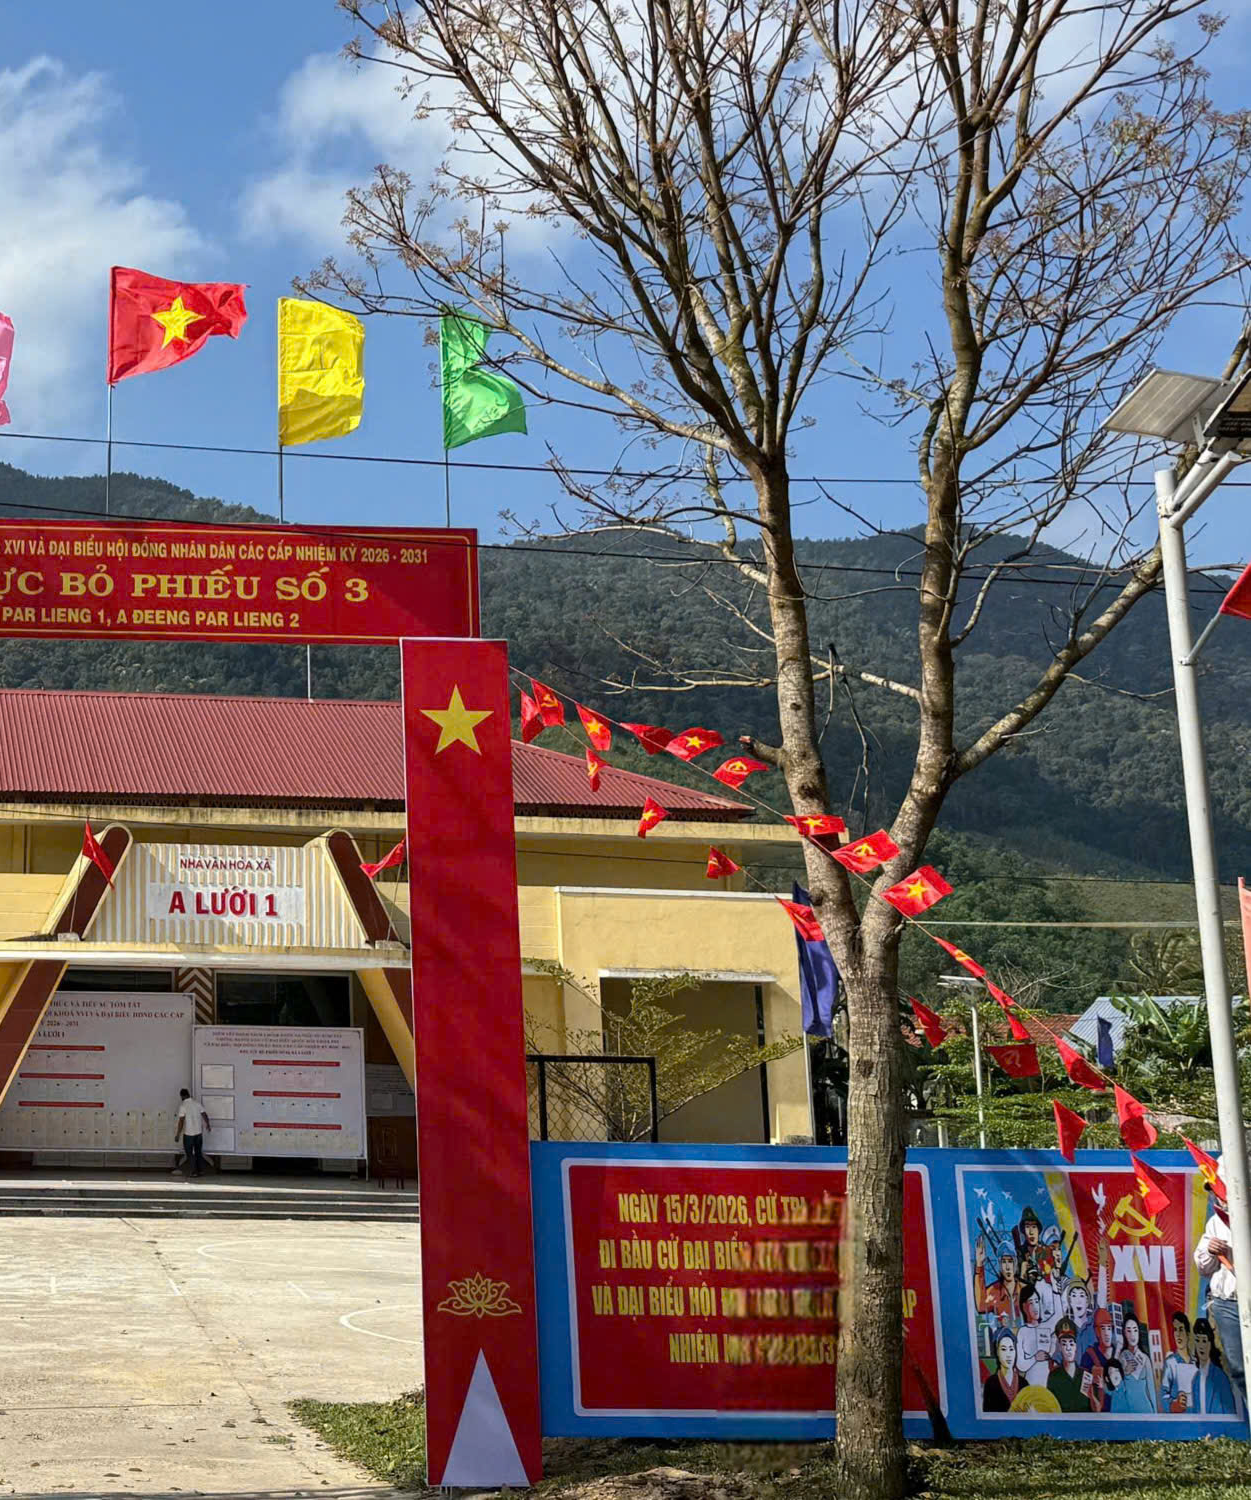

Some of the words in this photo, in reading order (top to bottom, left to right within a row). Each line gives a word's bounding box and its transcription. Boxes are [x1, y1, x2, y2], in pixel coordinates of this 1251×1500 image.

[4, 539, 25, 555] XVI
[29, 536, 45, 555] VÀ
[49, 541, 70, 560] ĐẠI
[74, 534, 103, 556] BIỂU
[107, 538, 128, 561] HỘI
[132, 536, 167, 558] ĐỒNG
[171, 540, 206, 559] NHÂN
[210, 541, 235, 559] DÂN
[239, 541, 264, 560] CÁC
[267, 539, 292, 560] CẤP
[296, 543, 336, 565] NHIỆM
[339, 543, 357, 561] KỲ
[361, 548, 390, 563] 2026
[400, 549, 428, 564] 2031
[59, 563, 114, 597] BỎ
[131, 564, 261, 600] PHIẾU
[276, 566, 330, 601] SỐ
[344, 578, 369, 602] 3
[2, 607, 36, 622] PAR
[41, 608, 92, 623] LIENG
[97, 609, 111, 627] 1,
[116, 609, 128, 624] A
[132, 609, 190, 625] ĐEENG
[195, 611, 229, 626] PAR
[233, 612, 285, 627] LIENG
[289, 613, 300, 628] 2
[204, 856, 227, 870] VĂN
[256, 858, 271, 870] XÃ
[169, 891, 186, 914] A
[196, 886, 256, 916] LƯỚI
[265, 894, 278, 916] 1
[618, 1189, 658, 1224] NGÀY
[663, 1194, 753, 1228] 15/3/2026,
[755, 1188, 778, 1225] CỬ
[599, 1239, 616, 1269] ĐI
[622, 1229, 652, 1269] BẦU
[657, 1232, 679, 1270] CỬ
[683, 1241, 709, 1275] ĐẠI
[1110, 1245, 1178, 1282] XVI
[591, 1280, 614, 1316] VÀ
[617, 1286, 644, 1321] ĐẠI
[649, 1276, 684, 1316] BIỂU
[689, 1282, 716, 1321] HỘI
[669, 1328, 719, 1368] NHIỆM
